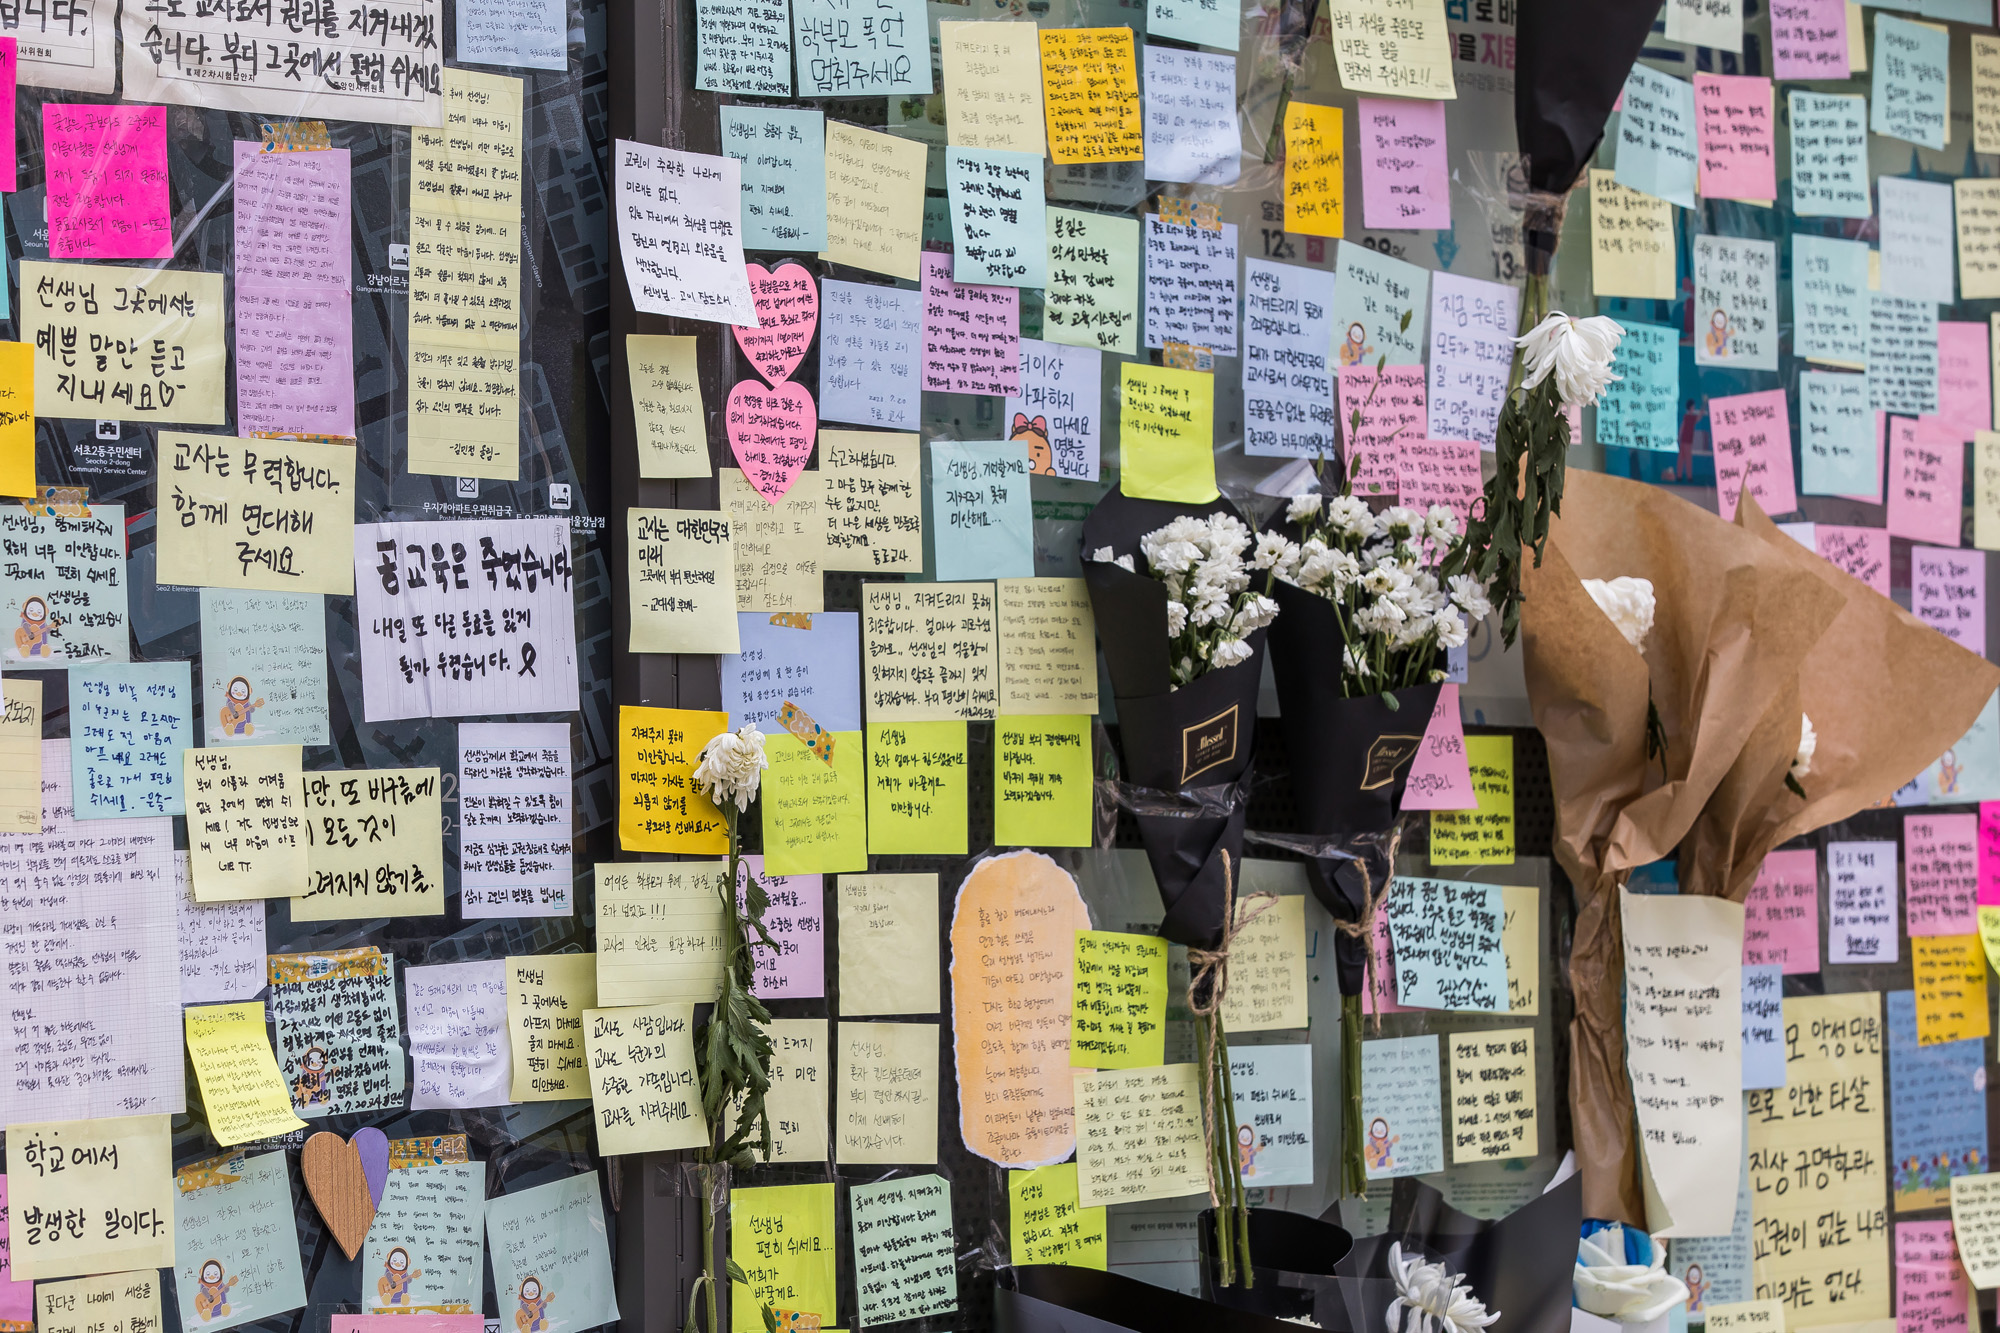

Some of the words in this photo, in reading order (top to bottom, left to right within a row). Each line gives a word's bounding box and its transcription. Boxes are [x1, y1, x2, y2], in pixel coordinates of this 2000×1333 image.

[281, 0, 340, 38] 권리를
[349, 5, 438, 49] 지켜내겠
[801, 17, 858, 56] 학부모
[863, 12, 904, 49] 폭언
[140, 24, 212, 70] 습니다.
[220, 33, 258, 75] 부디
[350, 52, 386, 89] 편히
[391, 55, 442, 96] 쉬세요
[811, 55, 911, 92] 멈춰주세요
[657, 157, 685, 177] 추락한
[693, 166, 721, 181] 나라에
[627, 181, 652, 197] 미래는
[659, 186, 680, 205] 없다.
[24, 240, 44, 248] Seoun
[37, 275, 99, 314] 선생님
[114, 285, 195, 317] 그곳에서는
[356, 285, 382, 293] Gangnam
[1440, 294, 1467, 327] 지금
[1472, 298, 1507, 331] 우리들
[37, 323, 77, 367] 예쁜
[90, 333, 138, 372] 말만
[151, 339, 185, 377] 듣고
[57, 374, 157, 410] 지내세요
[432, 401, 450, 414] 고인의
[454, 403, 473, 416] 명복을
[1054, 416, 1091, 435] 마세요
[74, 445, 142, 459] 서초2동주민센터
[1055, 437, 1085, 460] 명복을
[69, 465, 102, 474] Community
[104, 467, 126, 475] Service
[128, 468, 147, 476] Center
[85, 457, 108, 465] Seocho
[109, 459, 130, 467] 2-dong
[174, 443, 230, 477] 교사는
[243, 449, 340, 494] 무력합니다.
[1059, 459, 1089, 478] 빕니다
[990, 484, 1007, 505] 못해
[171, 485, 228, 527] 함께
[242, 504, 314, 536] 연대해
[423, 502, 513, 517] 무지개아파트우편취급국
[950, 511, 1001, 528] 미안해요...
[638, 516, 669, 541] 교사는
[677, 518, 729, 544] 대한민국의
[3, 539, 28, 557] 못해
[35, 544, 57, 563] 너무
[65, 541, 122, 561] 미안합니다.
[236, 542, 304, 576] 주세요.
[639, 545, 663, 566] 미래
[377, 539, 469, 595] 공교육은
[480, 537, 572, 593] 죽었습니다
[47, 590, 90, 606] 선생님을
[374, 617, 407, 643] 내일
[412, 615, 428, 637] 또
[435, 613, 457, 639] 다른
[462, 609, 496, 637] 동료를
[502, 608, 531, 633] 잃게
[868, 616, 918, 635] 죄송합니다.
[926, 617, 956, 636] 얼마나
[399, 655, 430, 683] 될까
[437, 648, 510, 681] 두렵습니다.
[631, 726, 664, 743] 지켜주지
[668, 729, 683, 745] 못해
[464, 750, 507, 762] 선생님께서
[510, 751, 537, 762] 학교에서
[542, 749, 559, 762] 죽음을
[638, 749, 688, 765] 미안합니다.
[464, 767, 489, 779] 택하신
[491, 767, 513, 779] 까닭을
[516, 766, 567, 778] 생각하겠습니다.
[631, 772, 657, 787] 마지막
[662, 774, 684, 788] 가시는
[340, 779, 361, 805] 또
[368, 776, 434, 805] 비구름에
[633, 792, 659, 811] 외롭지
[663, 795, 687, 815] 않기를
[891, 802, 933, 819] 미안합니다.
[324, 817, 358, 848] 모든
[357, 814, 396, 843] 것이
[376, 863, 434, 895] 않기를.
[517, 968, 544, 986] 선생님
[521, 994, 528, 1005] 그
[533, 995, 568, 1009] 곳에서는
[523, 1016, 550, 1030] 아프지
[557, 1017, 581, 1030] 마세요
[632, 1015, 686, 1036] 사람입니다.
[528, 1035, 543, 1052] 울지
[548, 1038, 580, 1050] 마세요.
[1786, 1023, 1805, 1063] 모
[1812, 1017, 1880, 1057] 악성민원
[527, 1057, 549, 1072] 편히
[557, 1057, 587, 1071] 쉬세요.
[628, 1043, 666, 1063] 누군가의
[532, 1078, 569, 1092] 미안해요.
[601, 1077, 632, 1096] 소중한
[640, 1069, 696, 1093] 가족입니다.
[601, 1106, 635, 1128] 교사를
[640, 1100, 697, 1122] 지켜주세요.
[1748, 1088, 1784, 1123] 으로
[1789, 1082, 1823, 1118] 인한
[24, 1140, 118, 1177] 학교에서
[1750, 1148, 1789, 1195] 진상
[1795, 1144, 1878, 1190] 규명하라.
[24, 1206, 86, 1245] 발생한
[105, 1208, 165, 1239] 일이다.
[749, 1215, 783, 1235] 선생님
[1754, 1217, 1807, 1261] 교권이
[1817, 1209, 1851, 1248] 없는
[756, 1238, 783, 1258] 편히
[788, 1237, 833, 1256] 쉬세요...
[747, 1267, 779, 1283] 저희가
[45, 1294, 76, 1314] 꽃다운
[87, 1290, 114, 1304] 나이에
[125, 1283, 151, 1299] 세상을
[755, 1285, 799, 1306] 바꿀게요.
[1756, 1276, 1813, 1309] 미래는
[1825, 1268, 1864, 1302] 없다.
